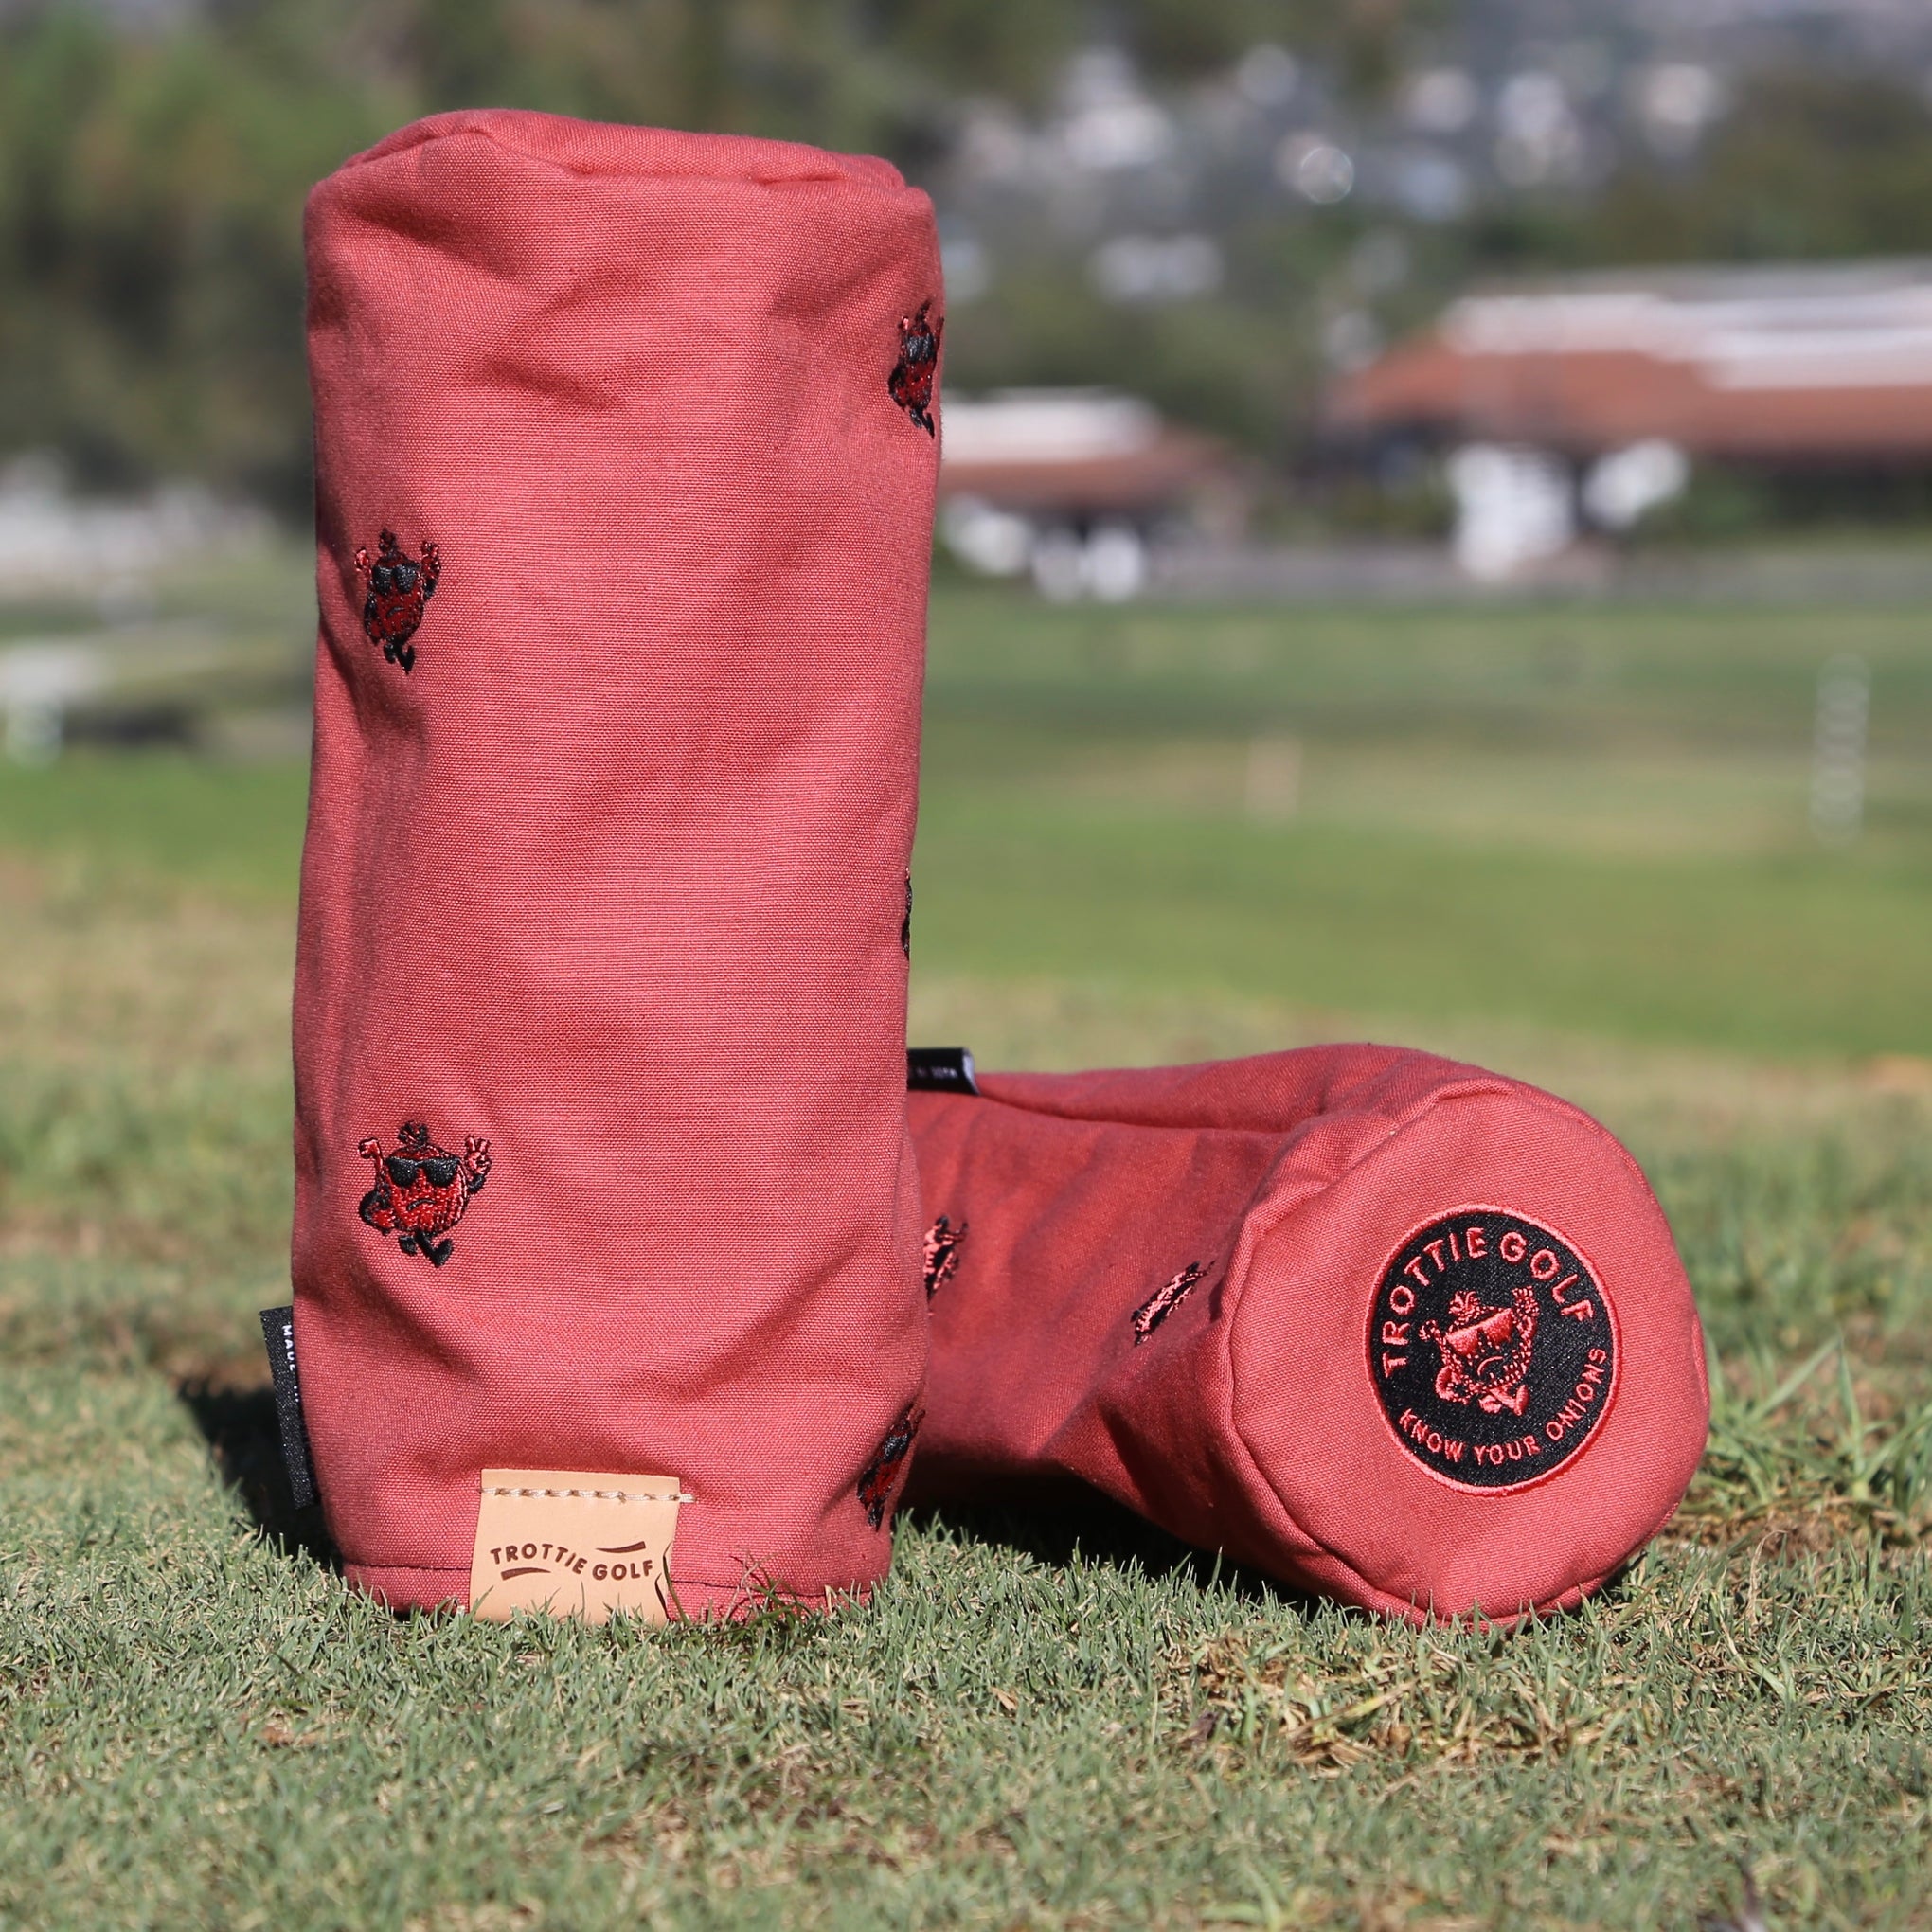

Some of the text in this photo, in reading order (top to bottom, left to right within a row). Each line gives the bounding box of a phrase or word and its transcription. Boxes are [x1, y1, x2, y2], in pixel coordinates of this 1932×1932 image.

[1382, 1227, 1595, 1378] TROTTIE GOLF
[1399, 1348, 1607, 1465] KNOW YOUR ONIONS
[491, 1543, 653, 1581] TROTTIE GOLF
